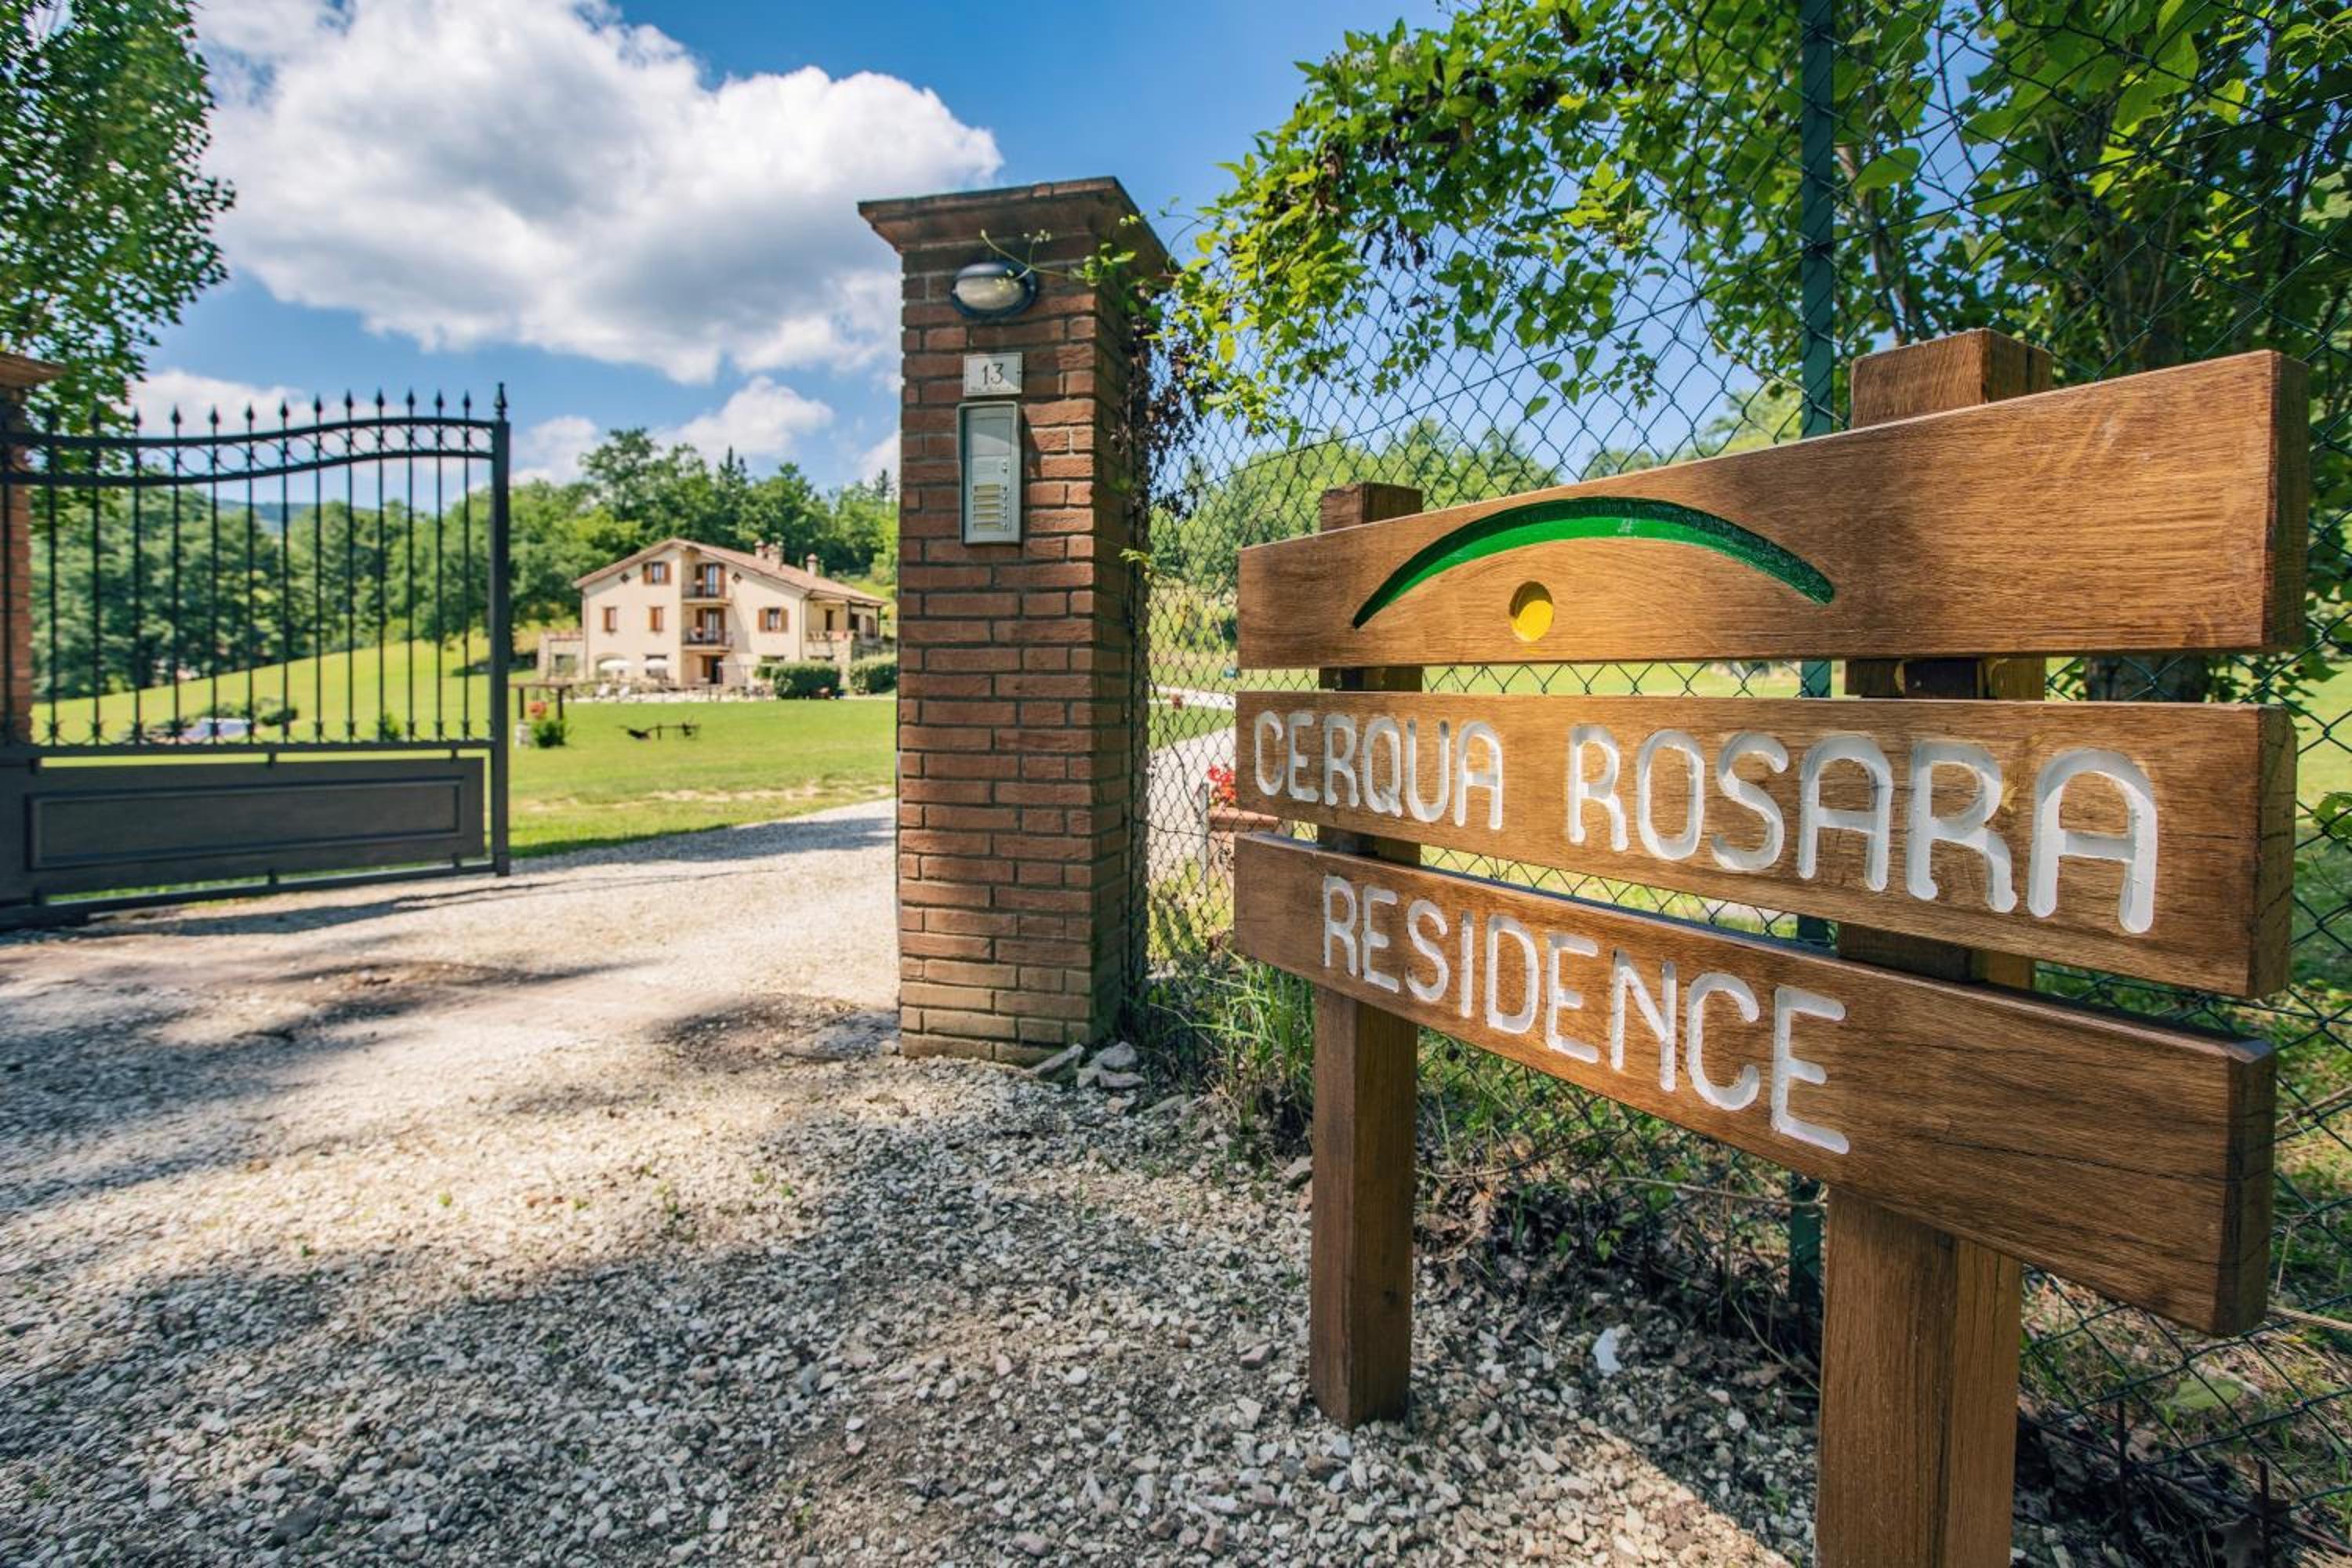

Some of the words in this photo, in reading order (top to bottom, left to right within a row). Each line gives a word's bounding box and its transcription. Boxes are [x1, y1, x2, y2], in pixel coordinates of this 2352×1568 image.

[982, 363, 1004, 385] 13
[1254, 710, 1503, 829] CERQUA
[1569, 724, 2158, 933] ROSARA
[1323, 875, 1849, 1154] RESIDENCE
